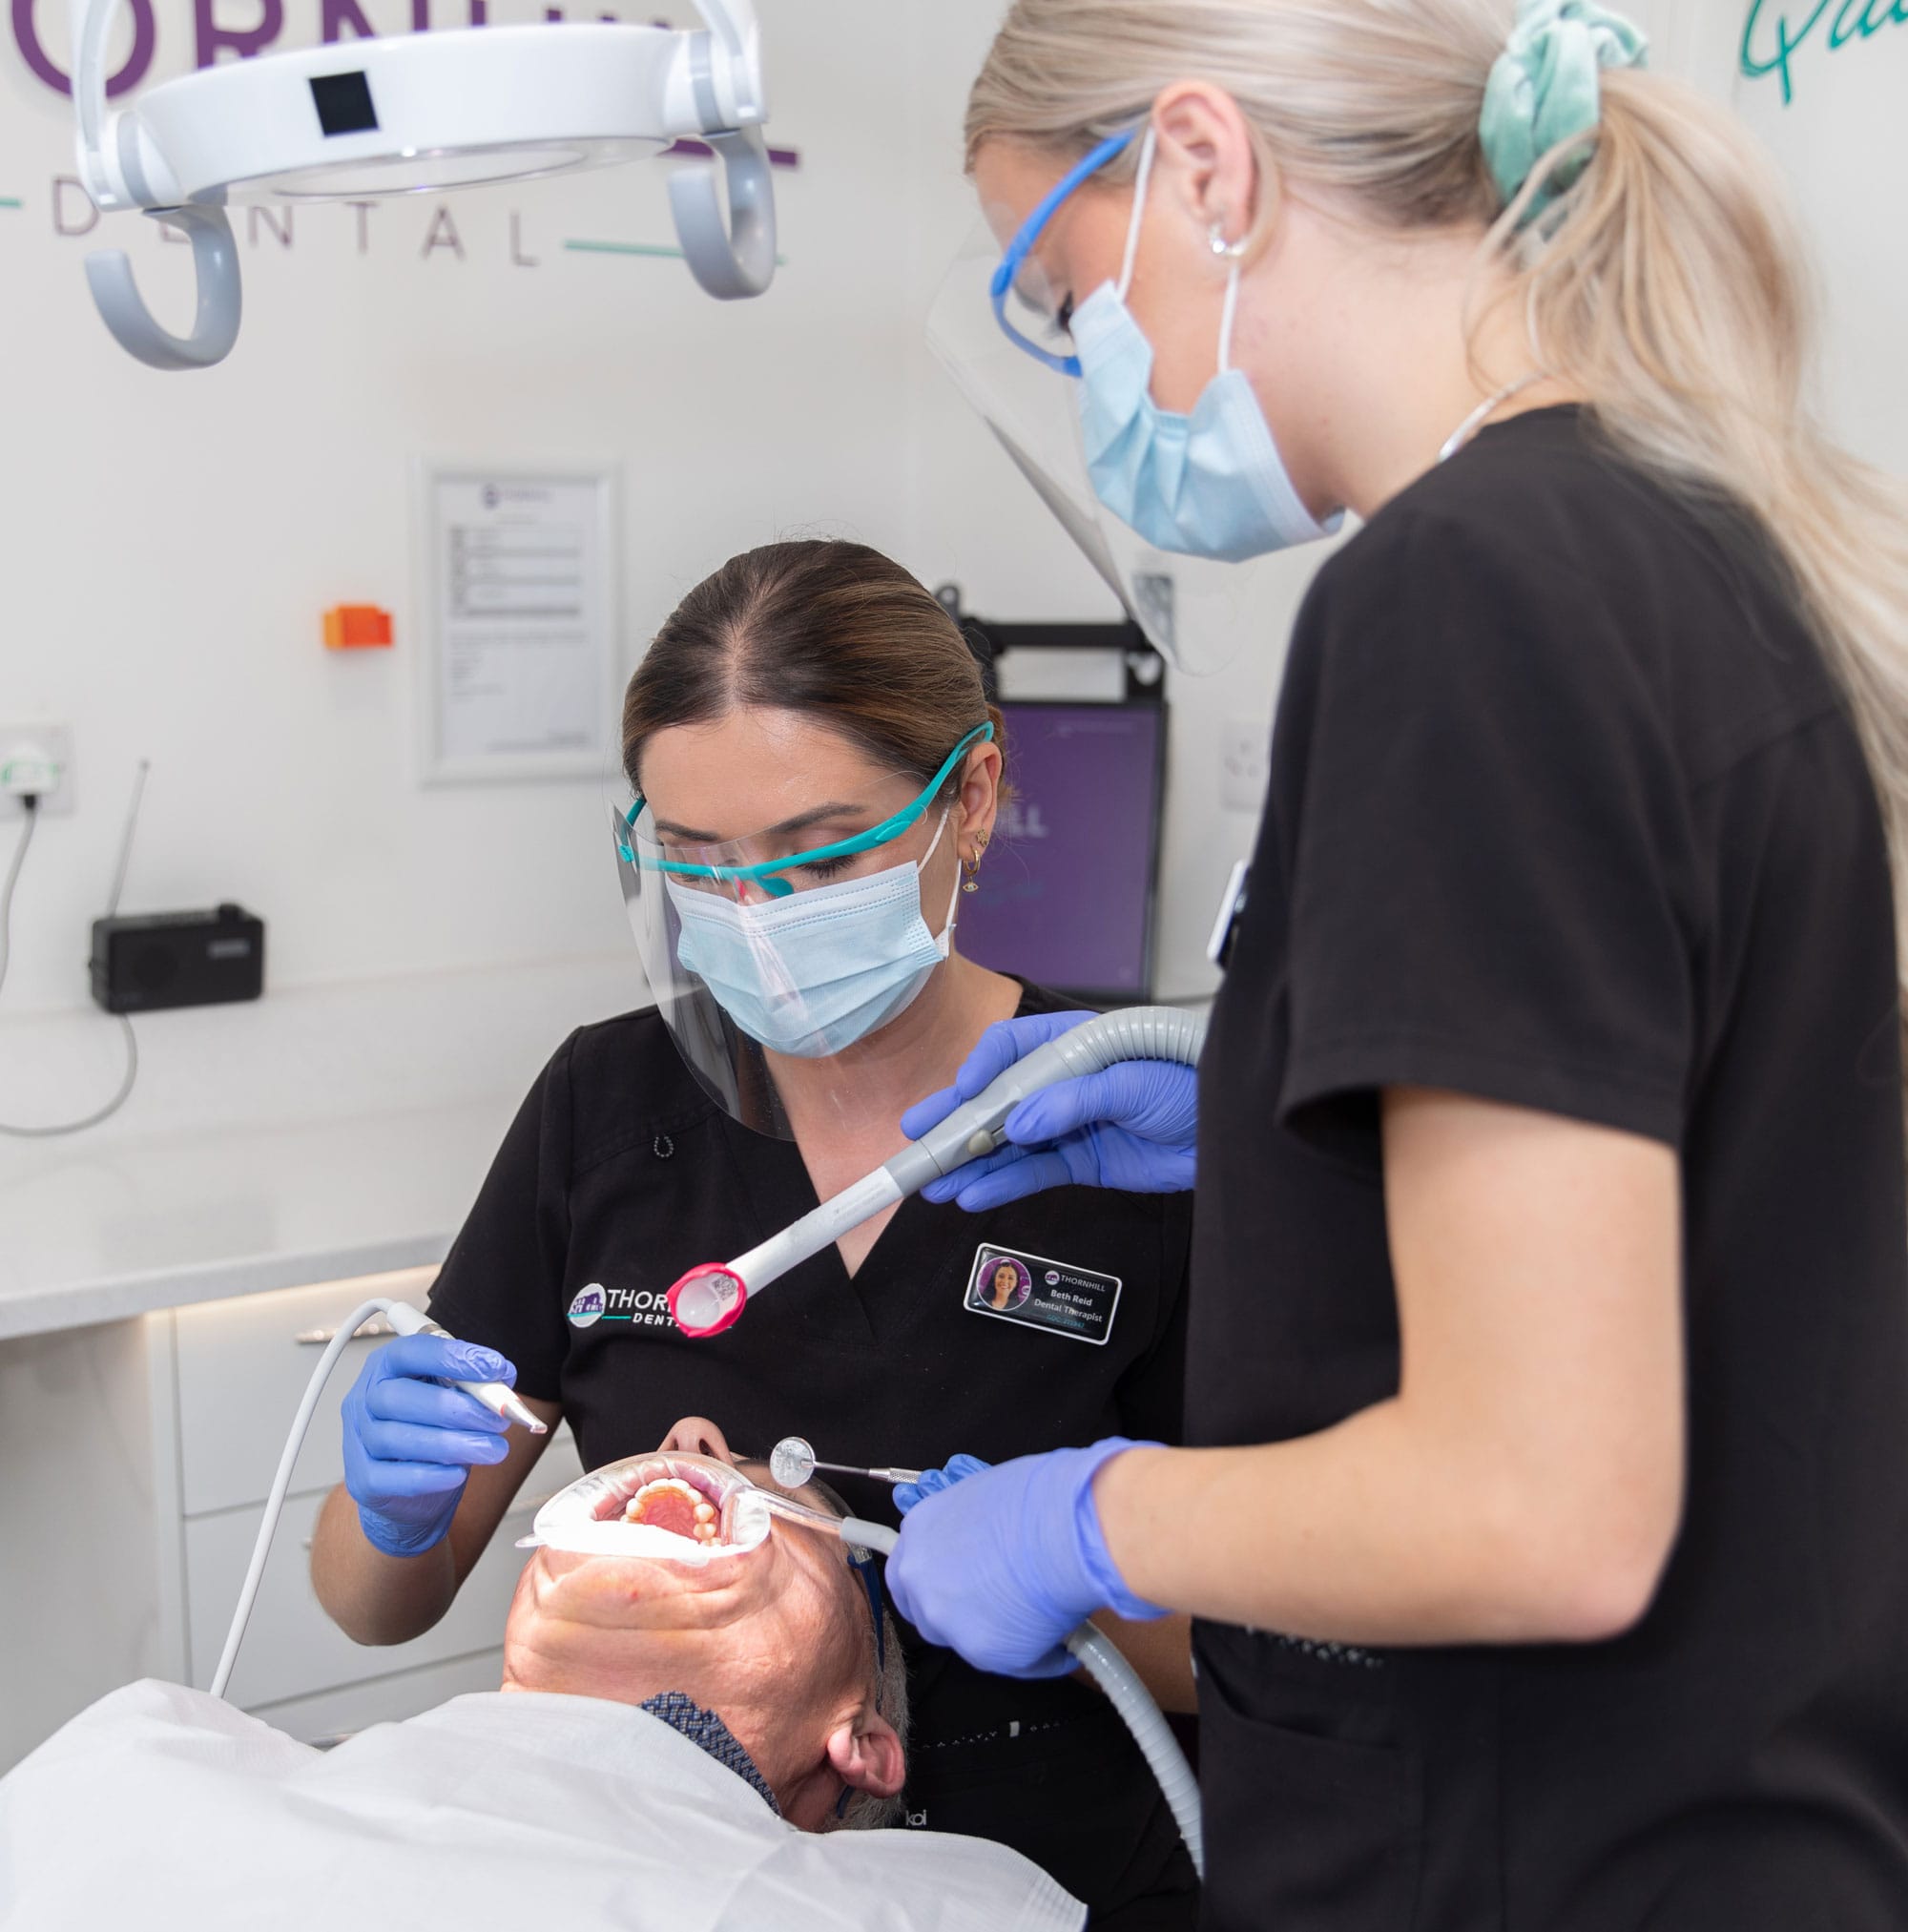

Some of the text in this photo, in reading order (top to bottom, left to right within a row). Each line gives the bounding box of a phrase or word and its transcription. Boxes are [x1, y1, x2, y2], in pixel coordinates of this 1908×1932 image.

[1061, 1274, 1106, 1292] THORNHILL
[607, 1289, 672, 1313] THOR
[1050, 1289, 1093, 1306] Beth Reid
[1034, 1298, 1103, 1322] Dental Therapist
[633, 1313, 679, 1327] DENT
